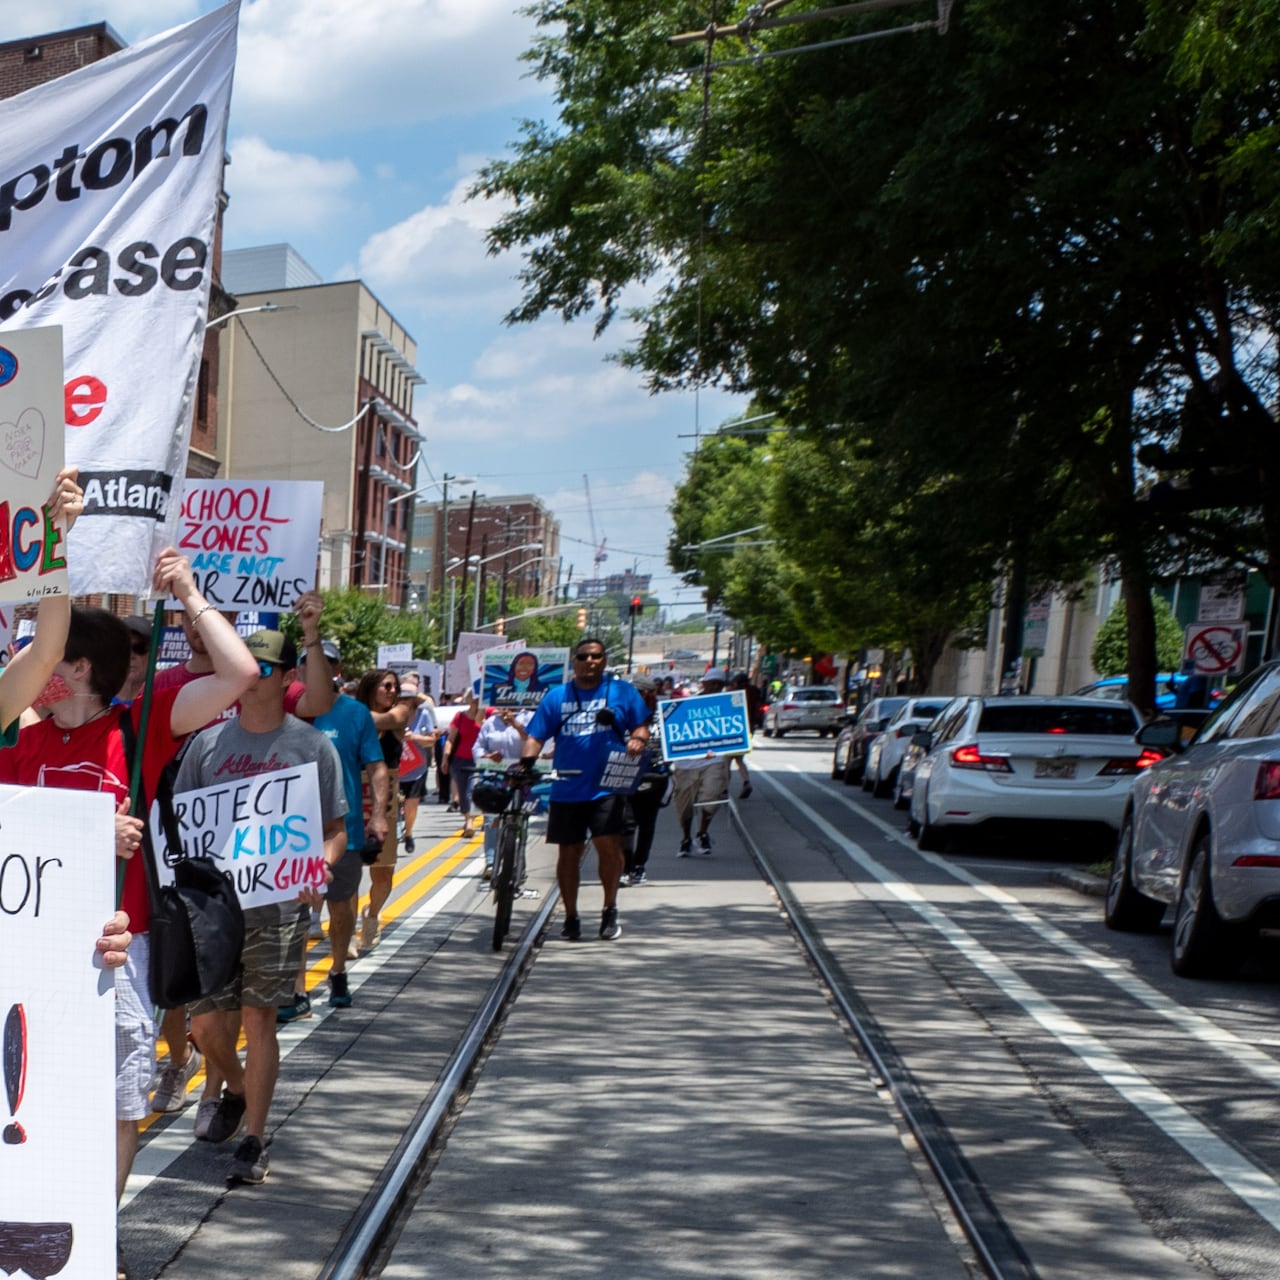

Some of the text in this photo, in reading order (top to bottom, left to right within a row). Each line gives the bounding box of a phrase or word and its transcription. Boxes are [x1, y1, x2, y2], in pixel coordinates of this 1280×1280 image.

[83, 477, 167, 516] Atlan
[179, 522, 272, 555] ZONES
[192, 552, 285, 577] ARE NOT
[232, 576, 308, 609] ZONES
[161, 650, 189, 659] LIVES
[162, 641, 183, 651] FOR
[667, 714, 744, 742] BARNES
[687, 705, 721, 720] IMANI
[159, 775, 301, 836] ROTECT
[233, 815, 311, 860] KIDS
[274, 856, 328, 889] GUNS
